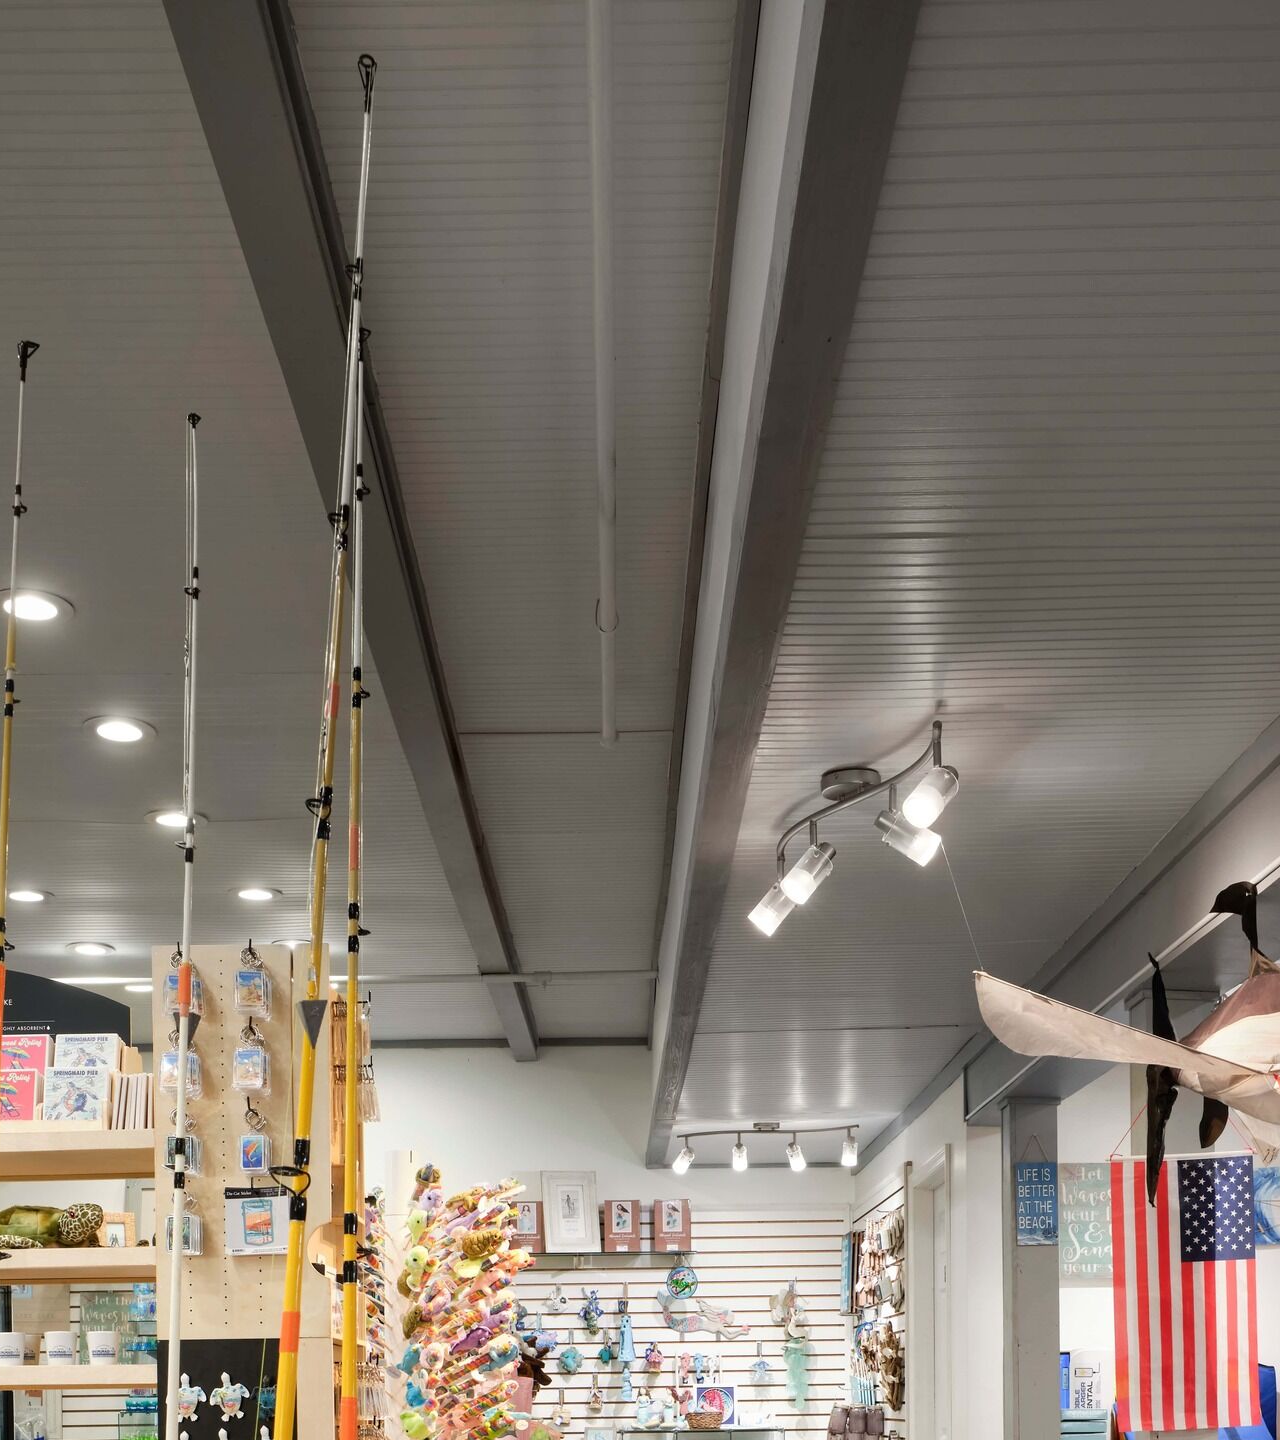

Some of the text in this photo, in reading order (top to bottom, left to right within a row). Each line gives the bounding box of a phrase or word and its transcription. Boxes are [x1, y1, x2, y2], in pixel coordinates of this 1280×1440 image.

[1018, 1168, 1051, 1182] LIFE IS
[1018, 1184, 1055, 1198] BETTER
[1019, 1200, 1053, 1214] AT THE
[1019, 1216, 1053, 1229] BEACH
[1063, 1210, 1099, 1223] your
[1085, 1222, 1106, 1243] &
[1064, 1264, 1100, 1275] your
